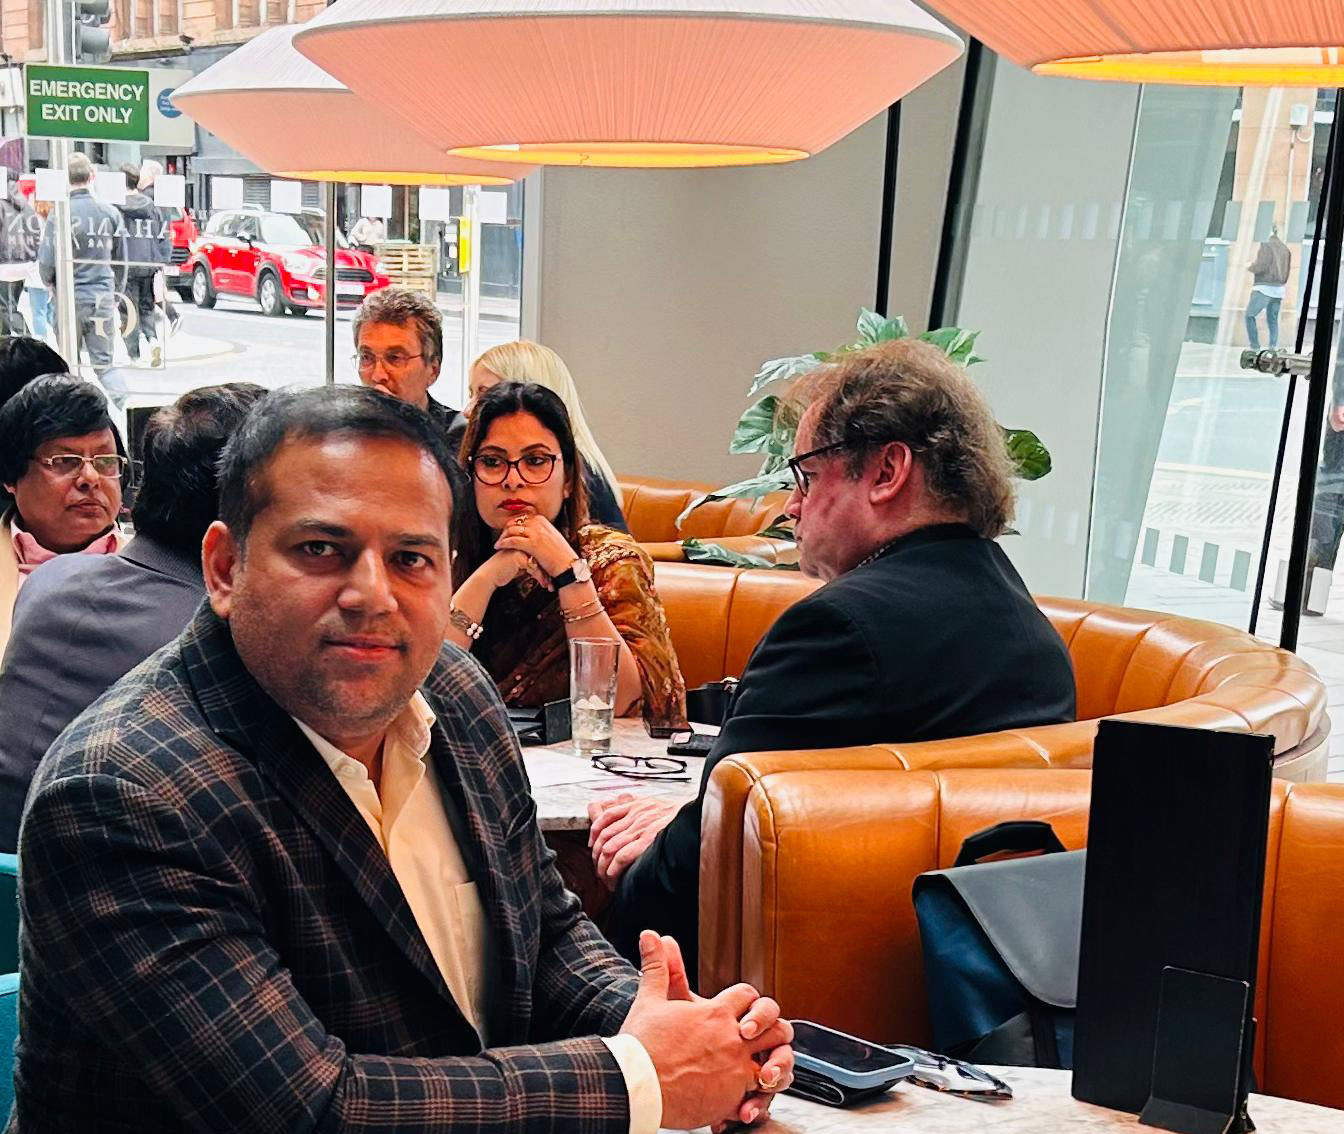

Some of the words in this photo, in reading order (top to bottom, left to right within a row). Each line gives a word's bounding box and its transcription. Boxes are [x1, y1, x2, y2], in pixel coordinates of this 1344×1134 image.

[29, 79, 144, 101] EMERGENCY
[41, 103, 81, 121] EXIT
[84, 105, 132, 124] ONLY
